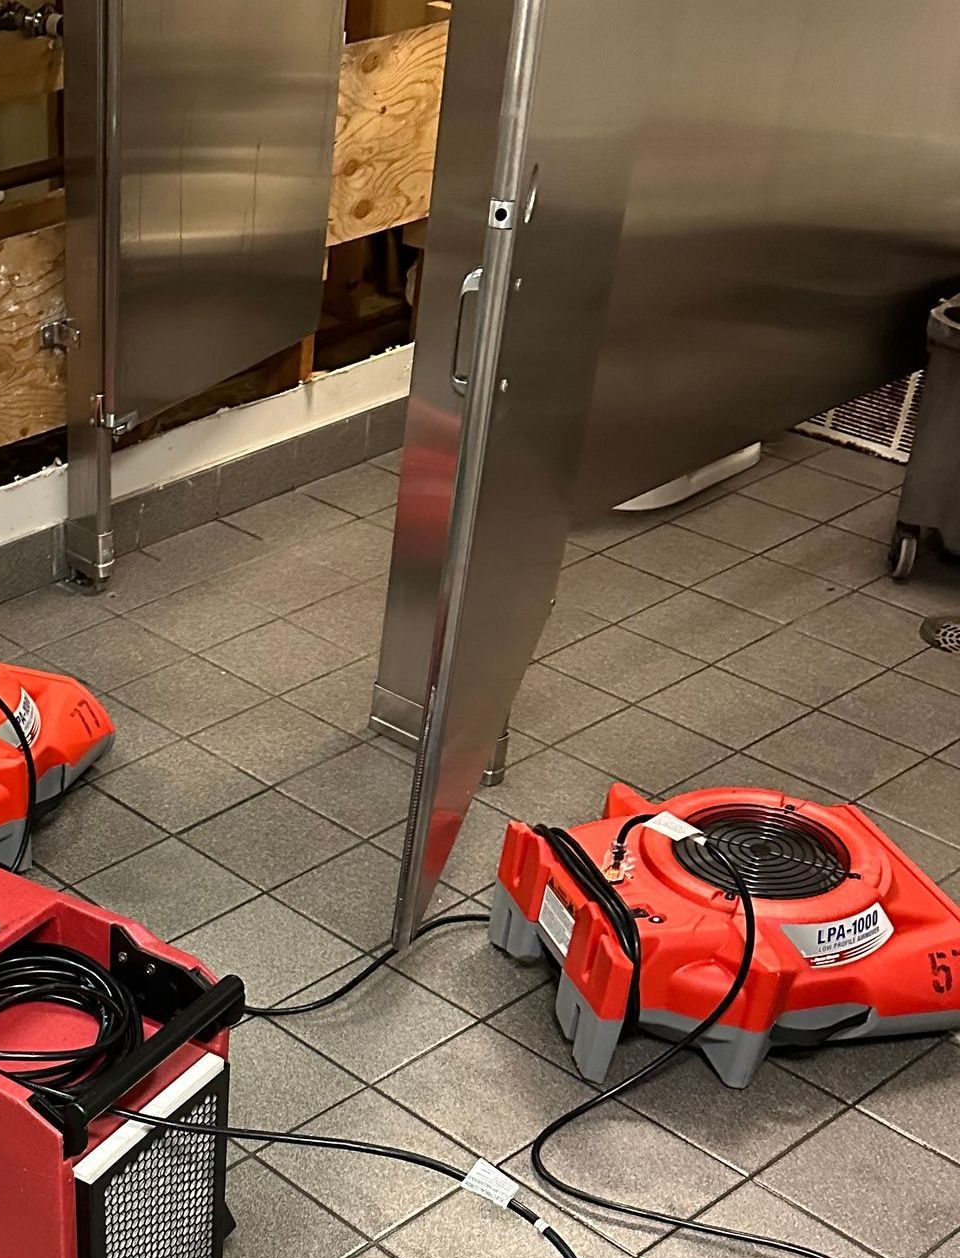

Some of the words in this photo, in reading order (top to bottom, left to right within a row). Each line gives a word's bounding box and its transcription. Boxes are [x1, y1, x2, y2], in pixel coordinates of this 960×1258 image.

[70, 698, 100, 738] 77
[817, 909, 878, 945] LPA-1000
[818, 944, 832, 953] LOW
[833, 937, 856, 949] PROFILE
